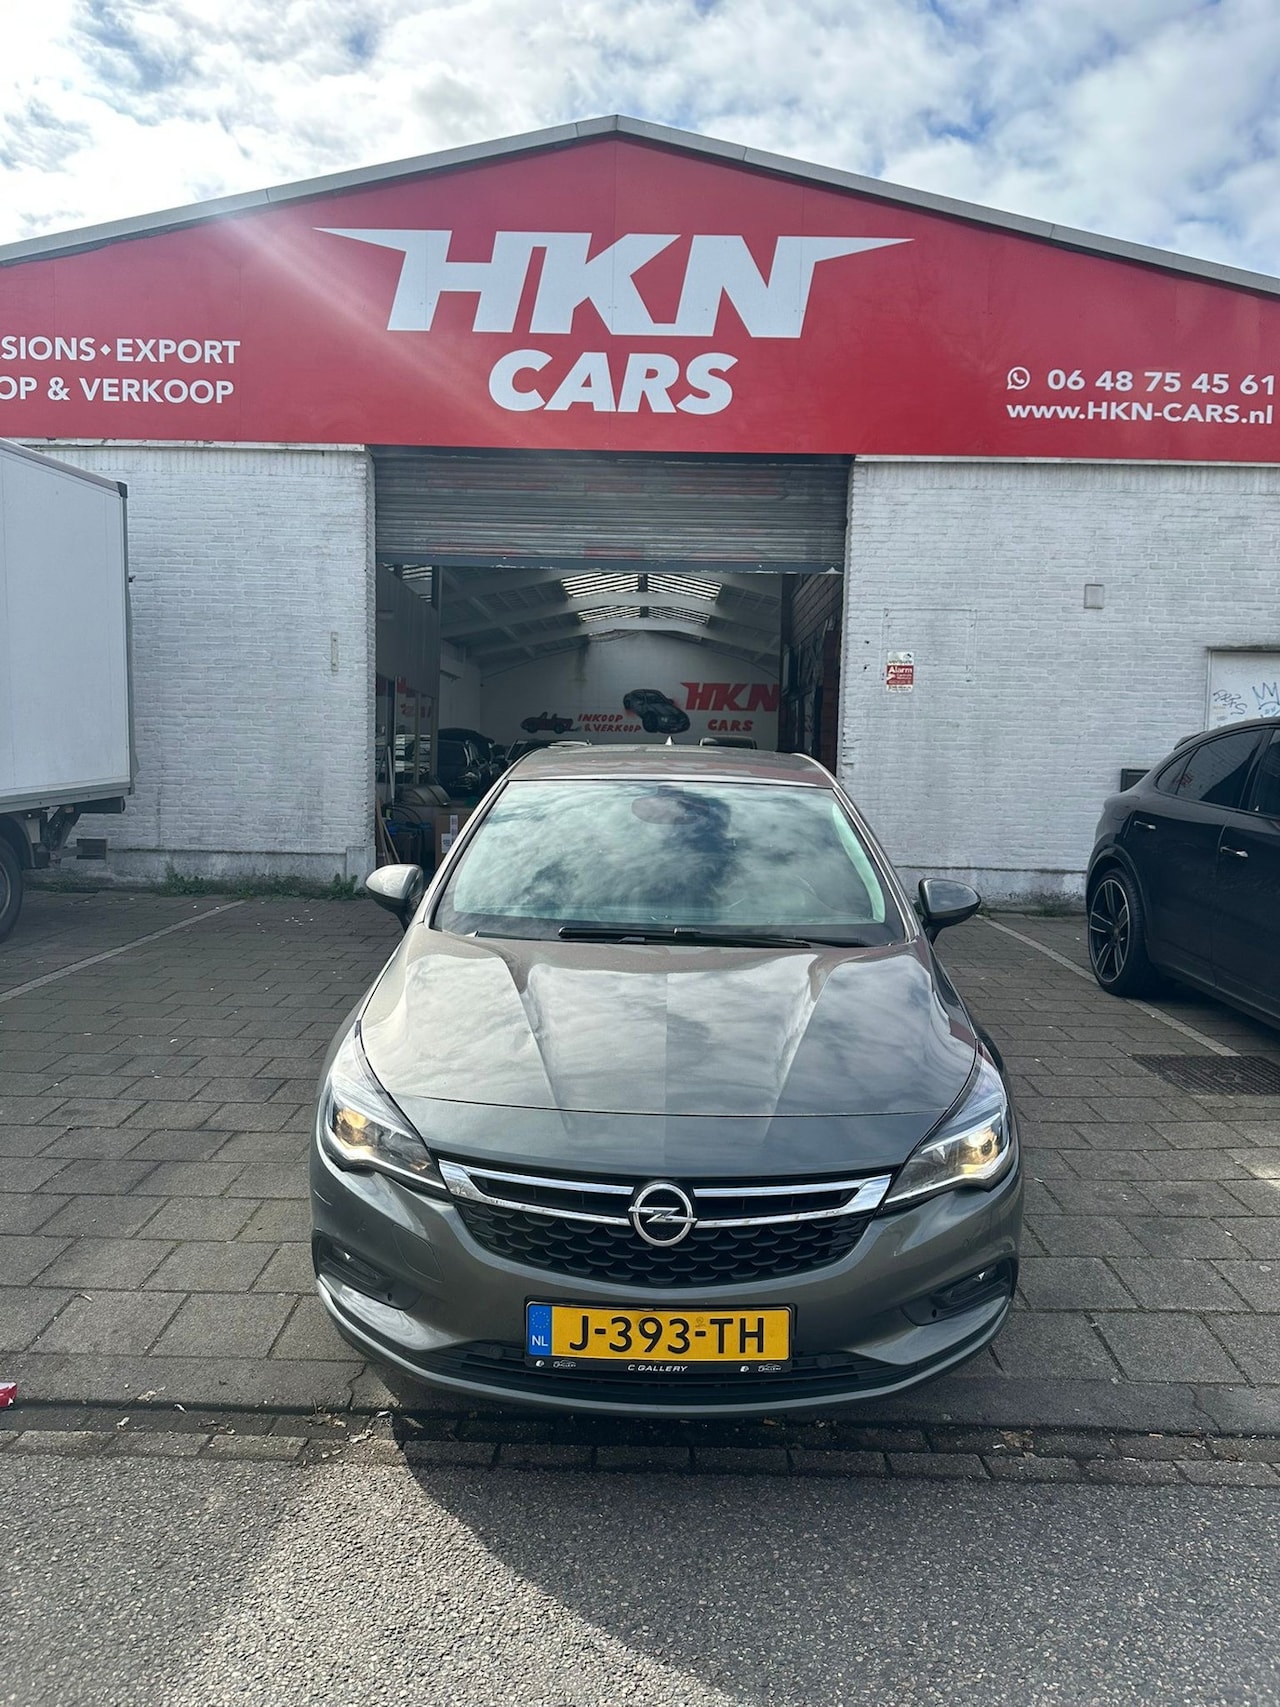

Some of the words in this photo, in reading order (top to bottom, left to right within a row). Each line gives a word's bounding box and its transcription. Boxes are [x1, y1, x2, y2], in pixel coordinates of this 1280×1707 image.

[312, 227, 914, 338] HKN
[0, 336, 96, 361] SIONS
[117, 338, 240, 364] EXPORT
[47, 377, 71, 401] &
[79, 377, 234, 404] VERKOOP
[489, 349, 738, 415] CARS
[1047, 369, 1086, 391] 06
[1095, 370, 1134, 392] 48
[1144, 371, 1181, 393] 75
[1191, 373, 1229, 394] 45
[1240, 374, 1274, 395] 61
[1006, 401, 1273, 424] www.HKN-CARS.nl
[681, 682, 779, 711] HKN
[579, 713, 624, 722] INKOOP
[708, 719, 754, 732] CARS
[531, 1335, 548, 1347] NL
[569, 1315, 765, 1354] J-393-TH
[638, 1364, 688, 1372] GALLERY
